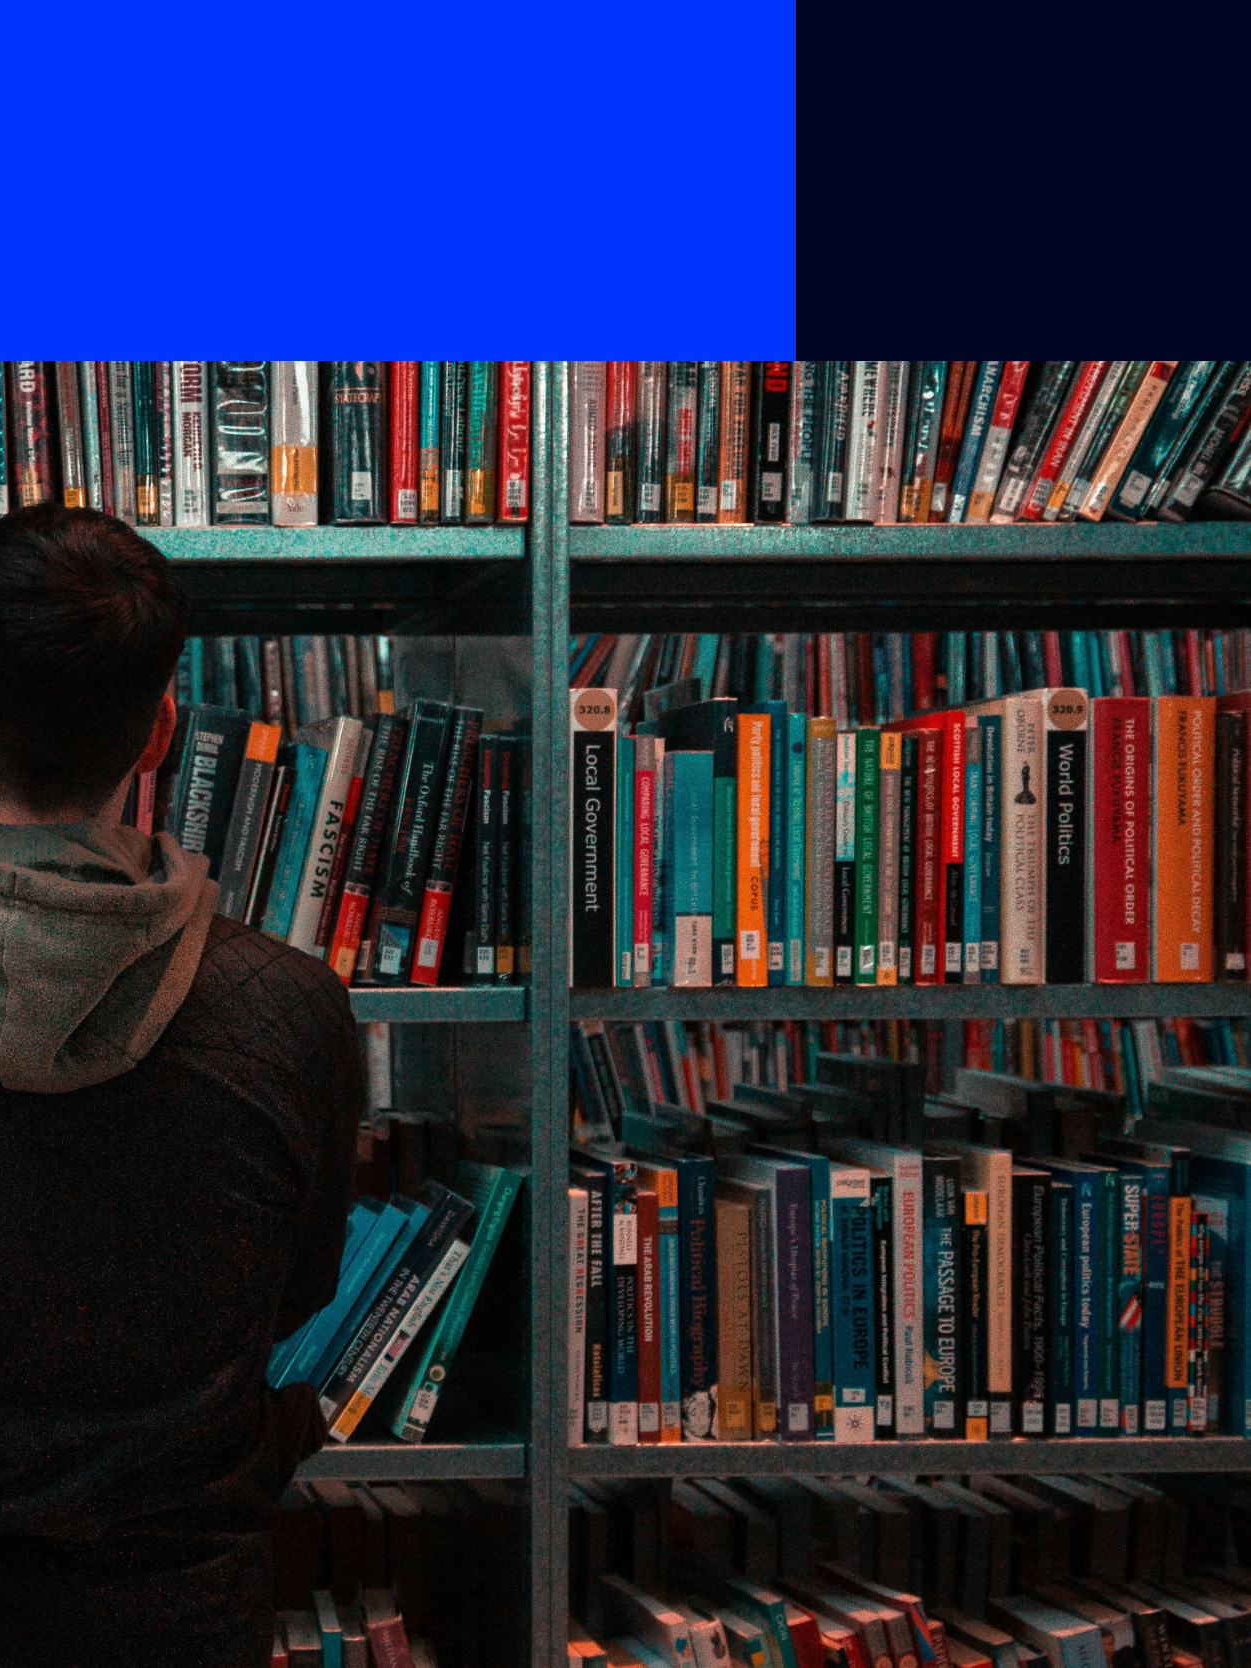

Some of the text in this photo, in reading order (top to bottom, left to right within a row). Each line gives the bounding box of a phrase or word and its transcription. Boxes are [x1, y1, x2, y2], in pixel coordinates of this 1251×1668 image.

[580, 706, 610, 714] 320.8
[750, 722, 762, 743] Party
[182, 755, 218, 852] BLACKSHIR
[951, 723, 961, 858] SCOTTISH LOCAL GOVERNMENT
[1058, 743, 1074, 865] World Politics
[1178, 711, 1186, 825] FRANCIS FUKUYAMA
[234, 839, 246, 871] FASCISM
[242, 816, 252, 836] AND
[310, 801, 343, 897] FASCISM
[584, 745, 600, 912] Local Government
[639, 823, 649, 845] LOCAL
[1015, 814, 1025, 873] POLITICAL
[1125, 719, 1135, 924] THE ORIGINS OF POLITICAL ORDER
[1192, 710, 1201, 933] POLITICAL ORDER AND POLITICAL DECAY
[395, 1274, 420, 1305] ARAB
[576, 1233, 584, 1263] GREAT
[591, 1191, 602, 1287] AFTER THE FALL
[644, 1236, 653, 1341] THE ARAB REVOLUTION
[851, 1206, 867, 1369] POLITICS IN EUROPE
[904, 1192, 915, 1318] EUROPEAN POLITICS
[1080, 1202, 1091, 1328] European politics today
[347, 1308, 401, 1383] NATIONALISM
[575, 1268, 583, 1333] REGRESSION
[690, 1219, 707, 1386] Political Biography
[938, 1227, 955, 1392] THE PASSAGE TO EUROPE
[1174, 1260, 1185, 1380] THE EUROPEAN UNION
